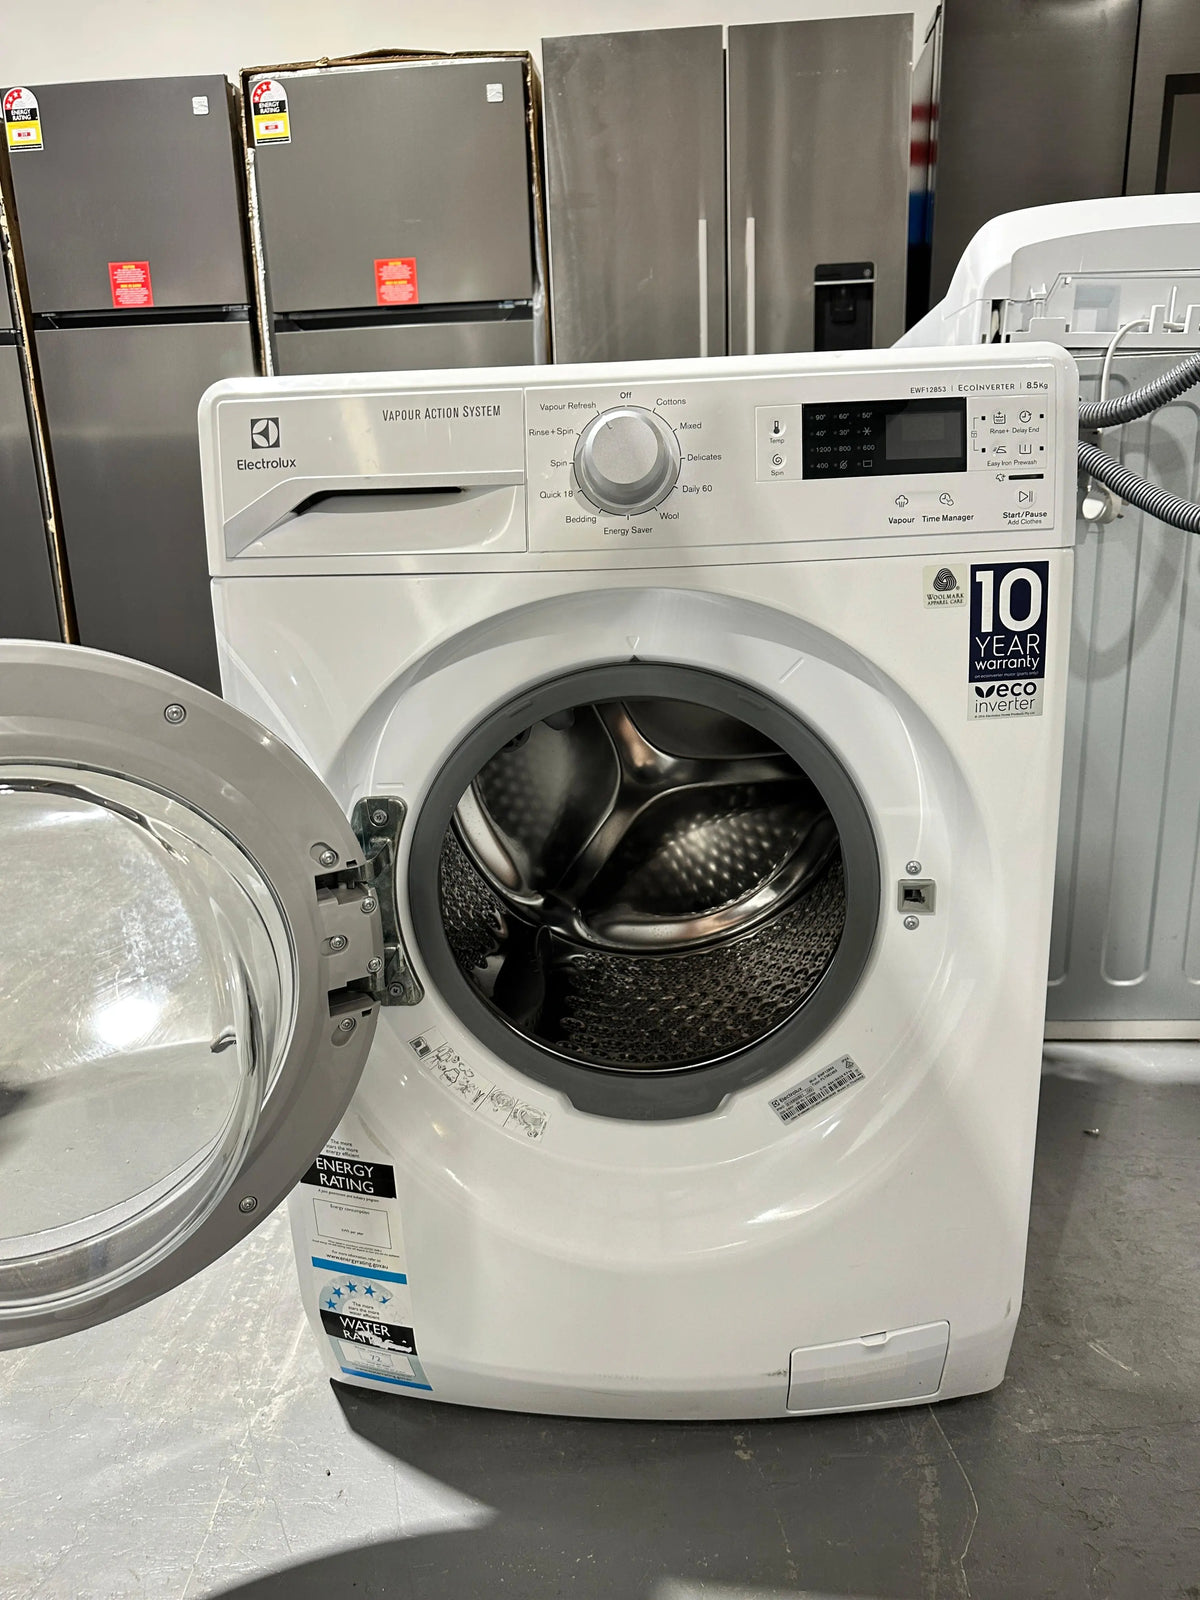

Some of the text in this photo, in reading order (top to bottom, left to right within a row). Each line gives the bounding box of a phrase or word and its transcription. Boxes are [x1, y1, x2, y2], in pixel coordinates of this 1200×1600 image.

[259, 101, 280, 109] ENERGY
[260, 106, 280, 114] RATING
[540, 401, 596, 412] Vapour Refresh
[656, 398, 686, 406] Cottons
[679, 422, 702, 430] Mixed
[529, 428, 550, 436] Rinse
[557, 427, 574, 436] Spin
[687, 453, 722, 461] Delicates
[237, 457, 297, 470] Electrolux
[550, 460, 567, 468] Spin
[539, 490, 574, 499] Quick 18
[682, 485, 700, 495] Daily
[660, 512, 679, 520] Wool
[888, 514, 974, 525] Vapour Time Manager
[1002, 511, 1048, 519] Start/Pause
[565, 516, 596, 524] Bedding
[927, 593, 964, 601] WOOLMARK
[975, 568, 1043, 633] 10
[975, 633, 1040, 658] YEAR
[974, 655, 1040, 671] warranty
[996, 681, 1037, 698] eco
[975, 697, 1035, 713] inverter
[315, 1157, 374, 1178] ENERGY
[320, 1173, 374, 1193] RATING
[339, 1316, 391, 1337] WATER
